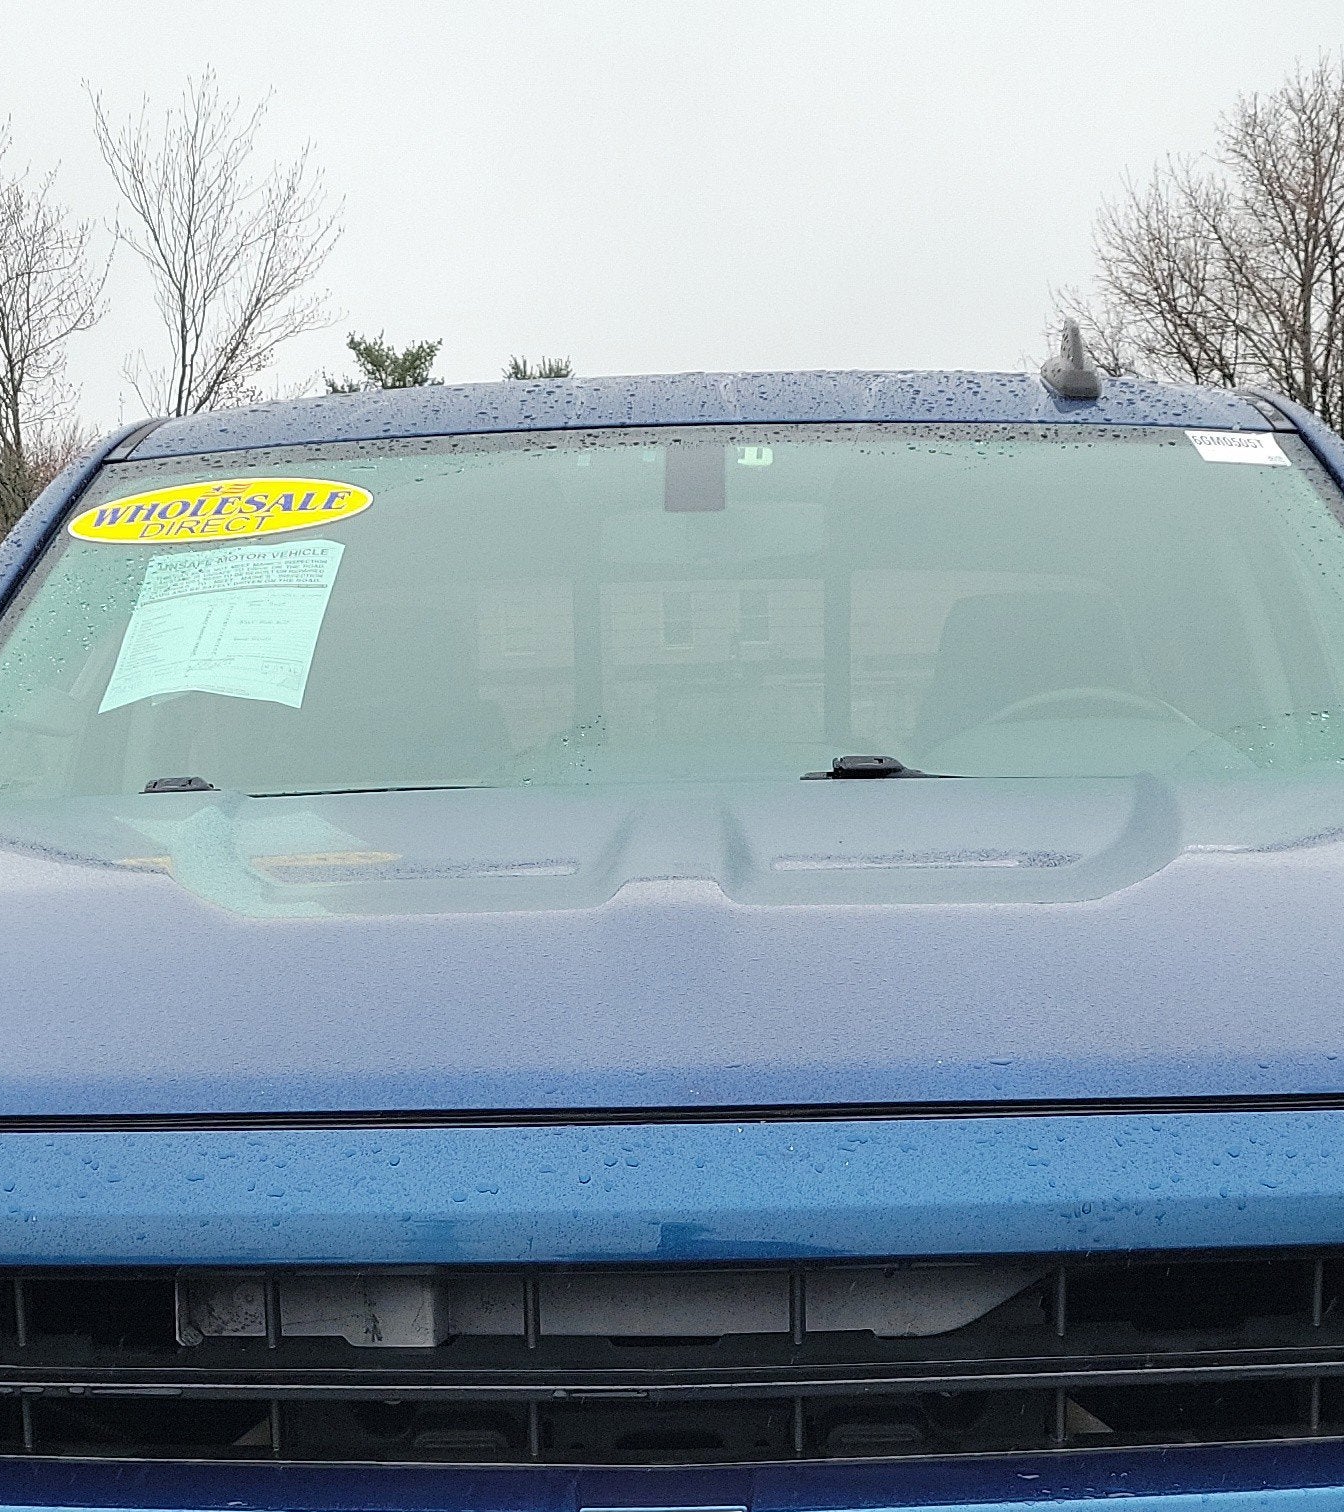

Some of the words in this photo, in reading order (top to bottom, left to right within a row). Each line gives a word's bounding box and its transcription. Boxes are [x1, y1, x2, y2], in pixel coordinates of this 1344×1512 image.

[94, 490, 351, 527] WHOLESALE
[138, 514, 275, 539] DIRECT
[216, 553, 267, 565] MOTOR
[271, 549, 329, 559] VEHICLE
